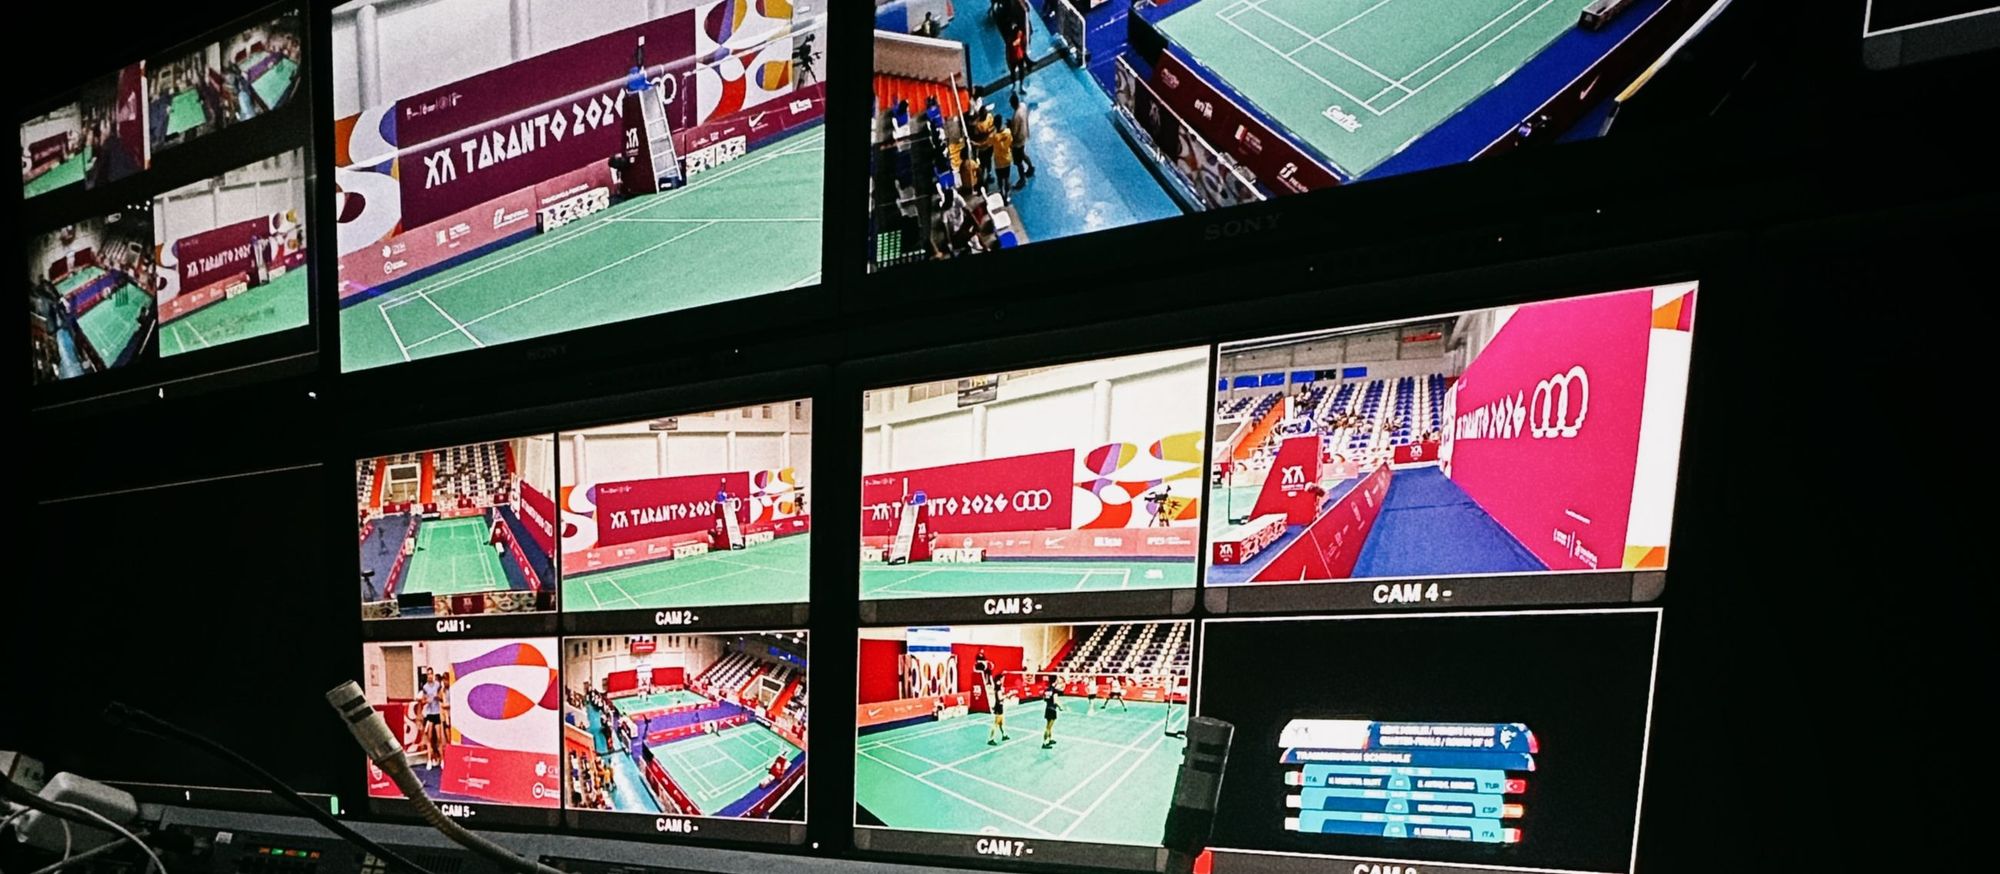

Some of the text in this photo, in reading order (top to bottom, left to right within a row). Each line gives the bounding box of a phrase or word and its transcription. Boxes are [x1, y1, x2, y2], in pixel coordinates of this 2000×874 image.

[424, 148, 457, 189] XX
[461, 109, 568, 174] TARANTO
[1203, 212, 1284, 241] SONY
[1489, 389, 1527, 440] 2026
[961, 491, 1009, 515] 2026
[630, 503, 687, 526] TARANTO
[1373, 585, 1420, 603] CAM
[1425, 583, 1439, 602] 4
[984, 598, 1020, 616] CAM
[1022, 598, 1033, 615] 3
[436, 621, 458, 633] CAM
[459, 620, 465, 632] 1
[655, 611, 683, 626] CAM
[684, 610, 692, 625] 2
[442, 803, 463, 819] CAM
[464, 806, 470, 818] 5
[656, 818, 682, 833] CAM
[683, 820, 692, 834] 6
[976, 839, 1011, 856] CAM
[1014, 840, 1024, 857] 7
